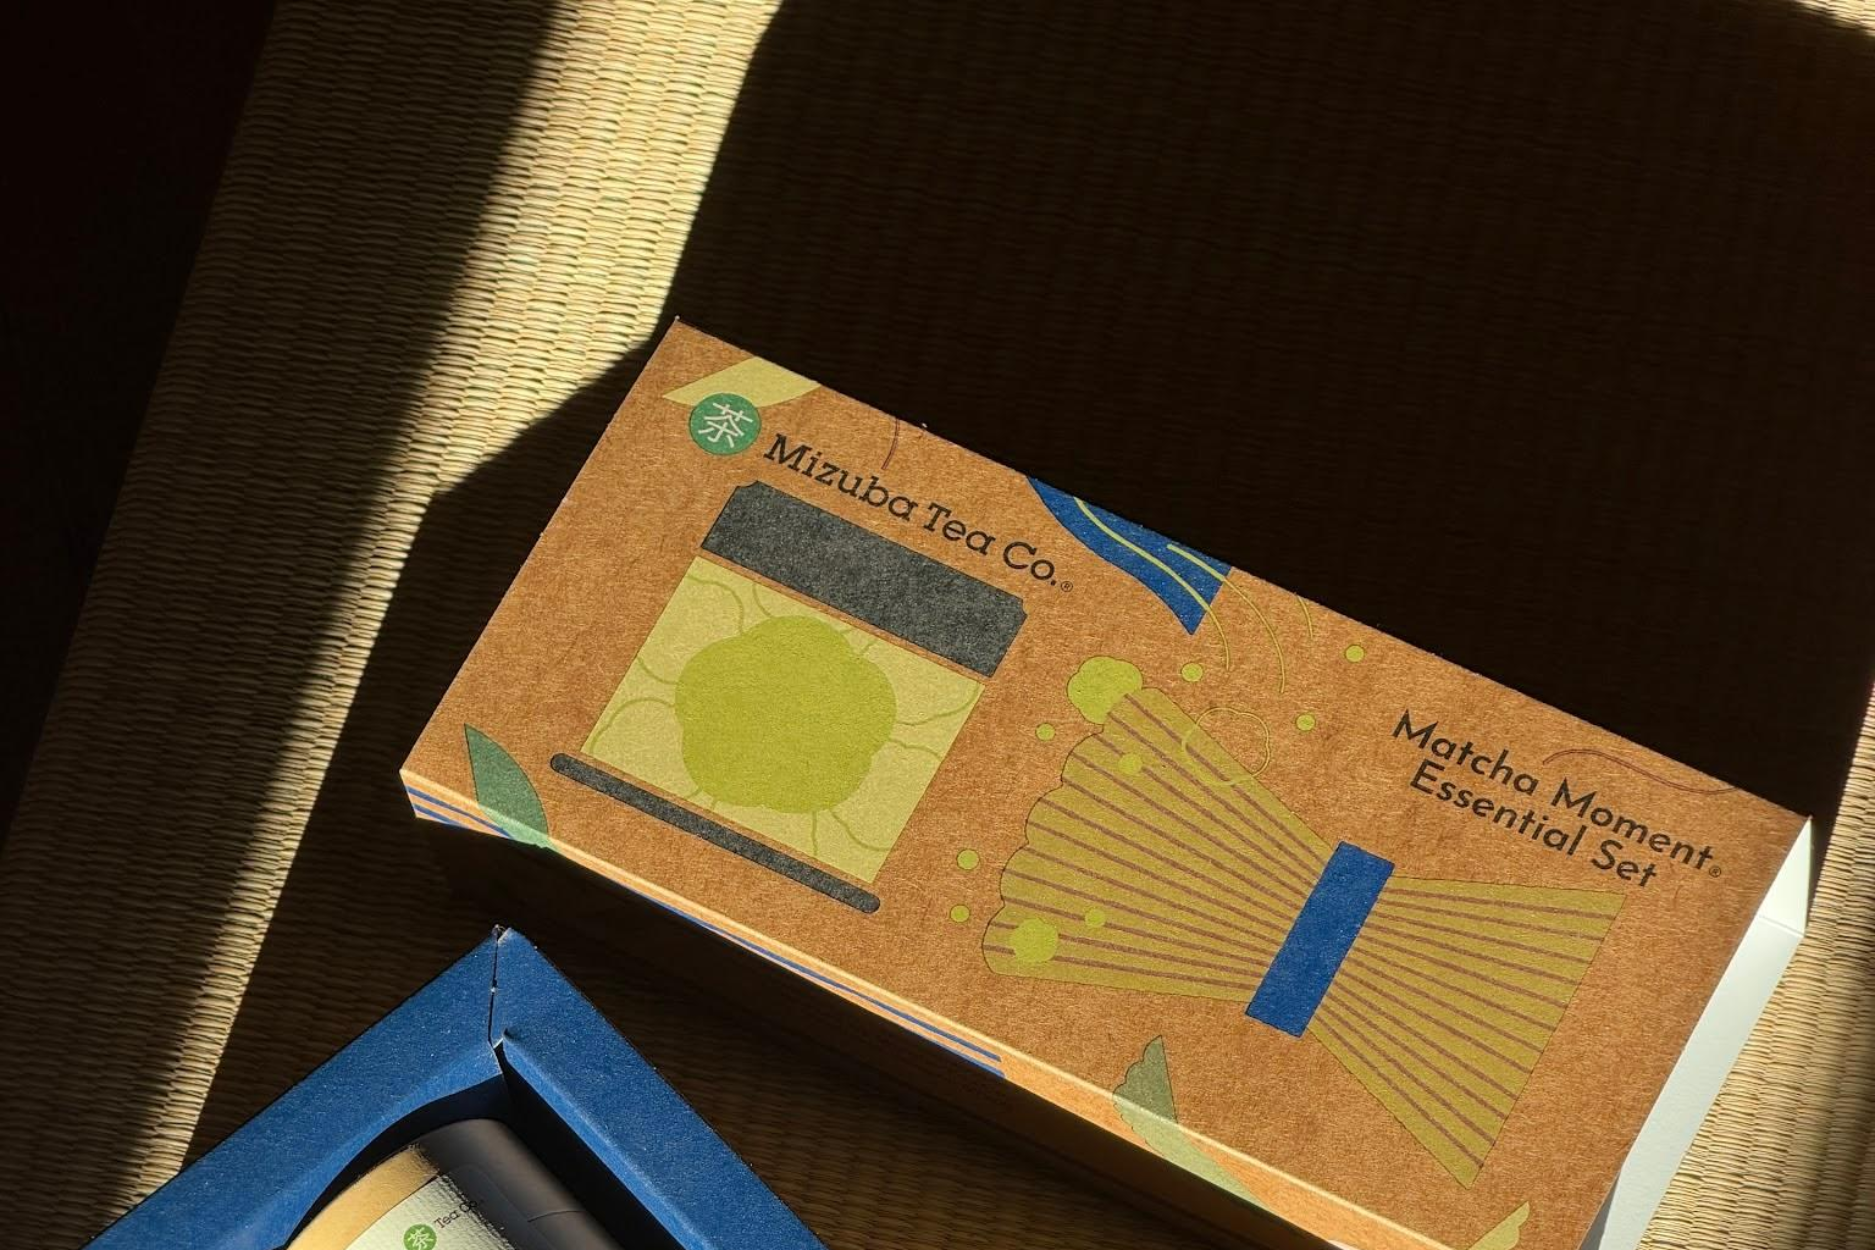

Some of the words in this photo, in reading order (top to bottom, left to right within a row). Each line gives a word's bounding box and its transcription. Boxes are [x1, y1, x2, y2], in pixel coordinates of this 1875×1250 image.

[763, 432, 917, 523] Mizuba
[916, 502, 997, 557] Tea
[1391, 708, 1540, 796] Matcha
[1410, 757, 1588, 857] Essential
[1591, 838, 1658, 888] Set
[434, 1210, 460, 1230] Tea
